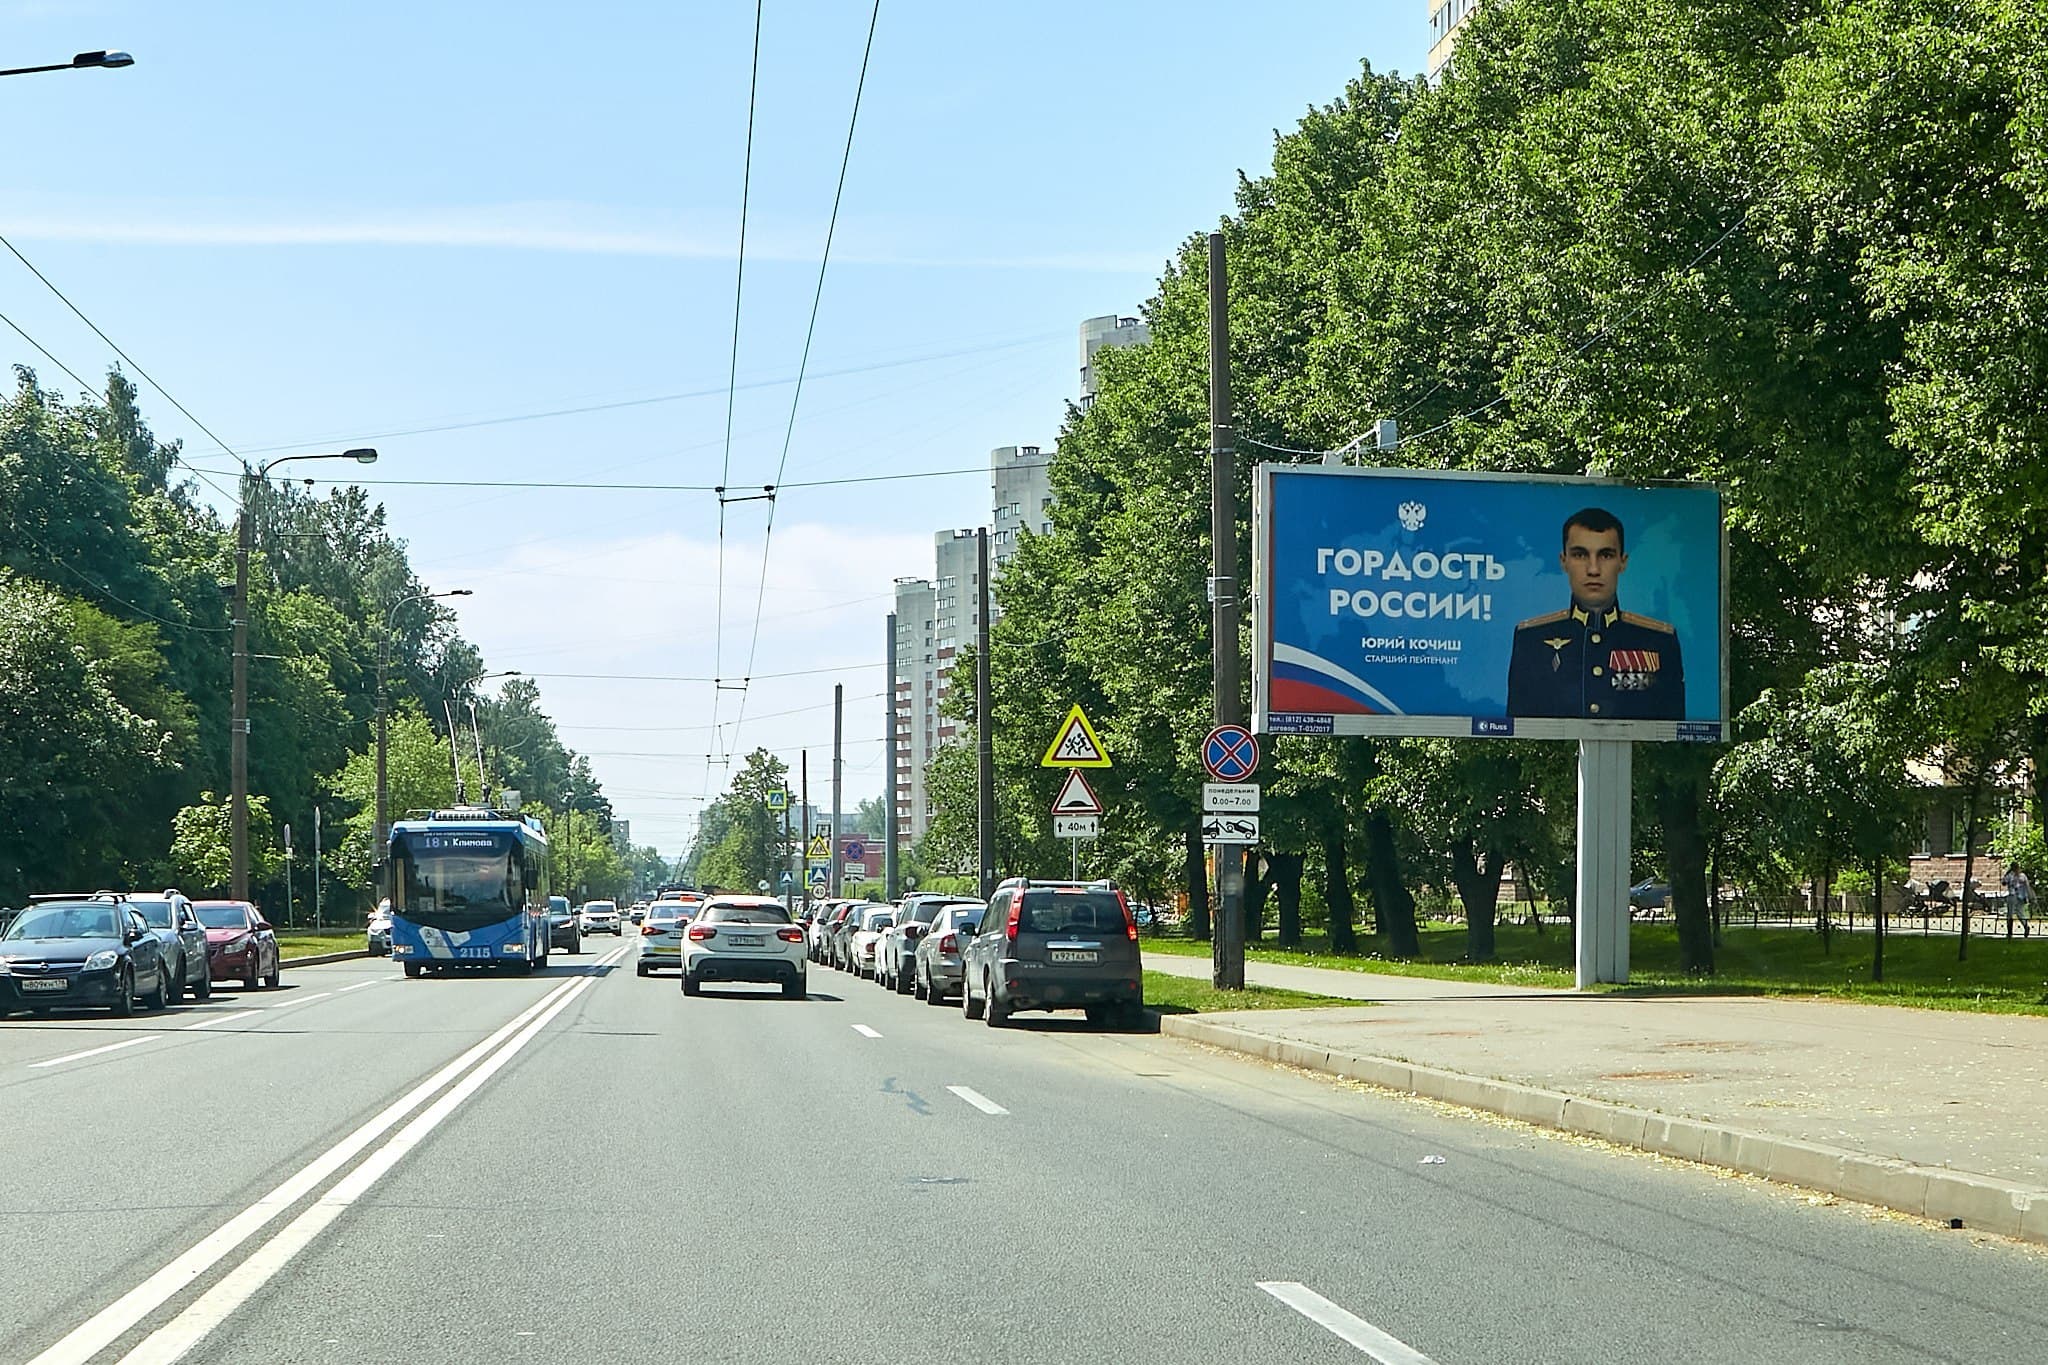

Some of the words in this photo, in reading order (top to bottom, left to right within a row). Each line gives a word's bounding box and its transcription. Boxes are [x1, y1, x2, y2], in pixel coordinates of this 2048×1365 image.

[1317, 548, 1506, 581] ГОРДОСТЬ
[1329, 589, 1492, 621] РОССИИ!
[1361, 636, 1405, 649] ЮРИЙ
[1409, 638, 1461, 651] КОЧИШ
[1364, 654, 1407, 664] СТАРШИЙ
[1409, 654, 1458, 665] ЛЕЙТЕНАНТ
[1489, 722, 1508, 731] Russ
[426, 837, 440, 848] 18
[814, 887, 824, 896] 40
[459, 947, 491, 958] 2115
